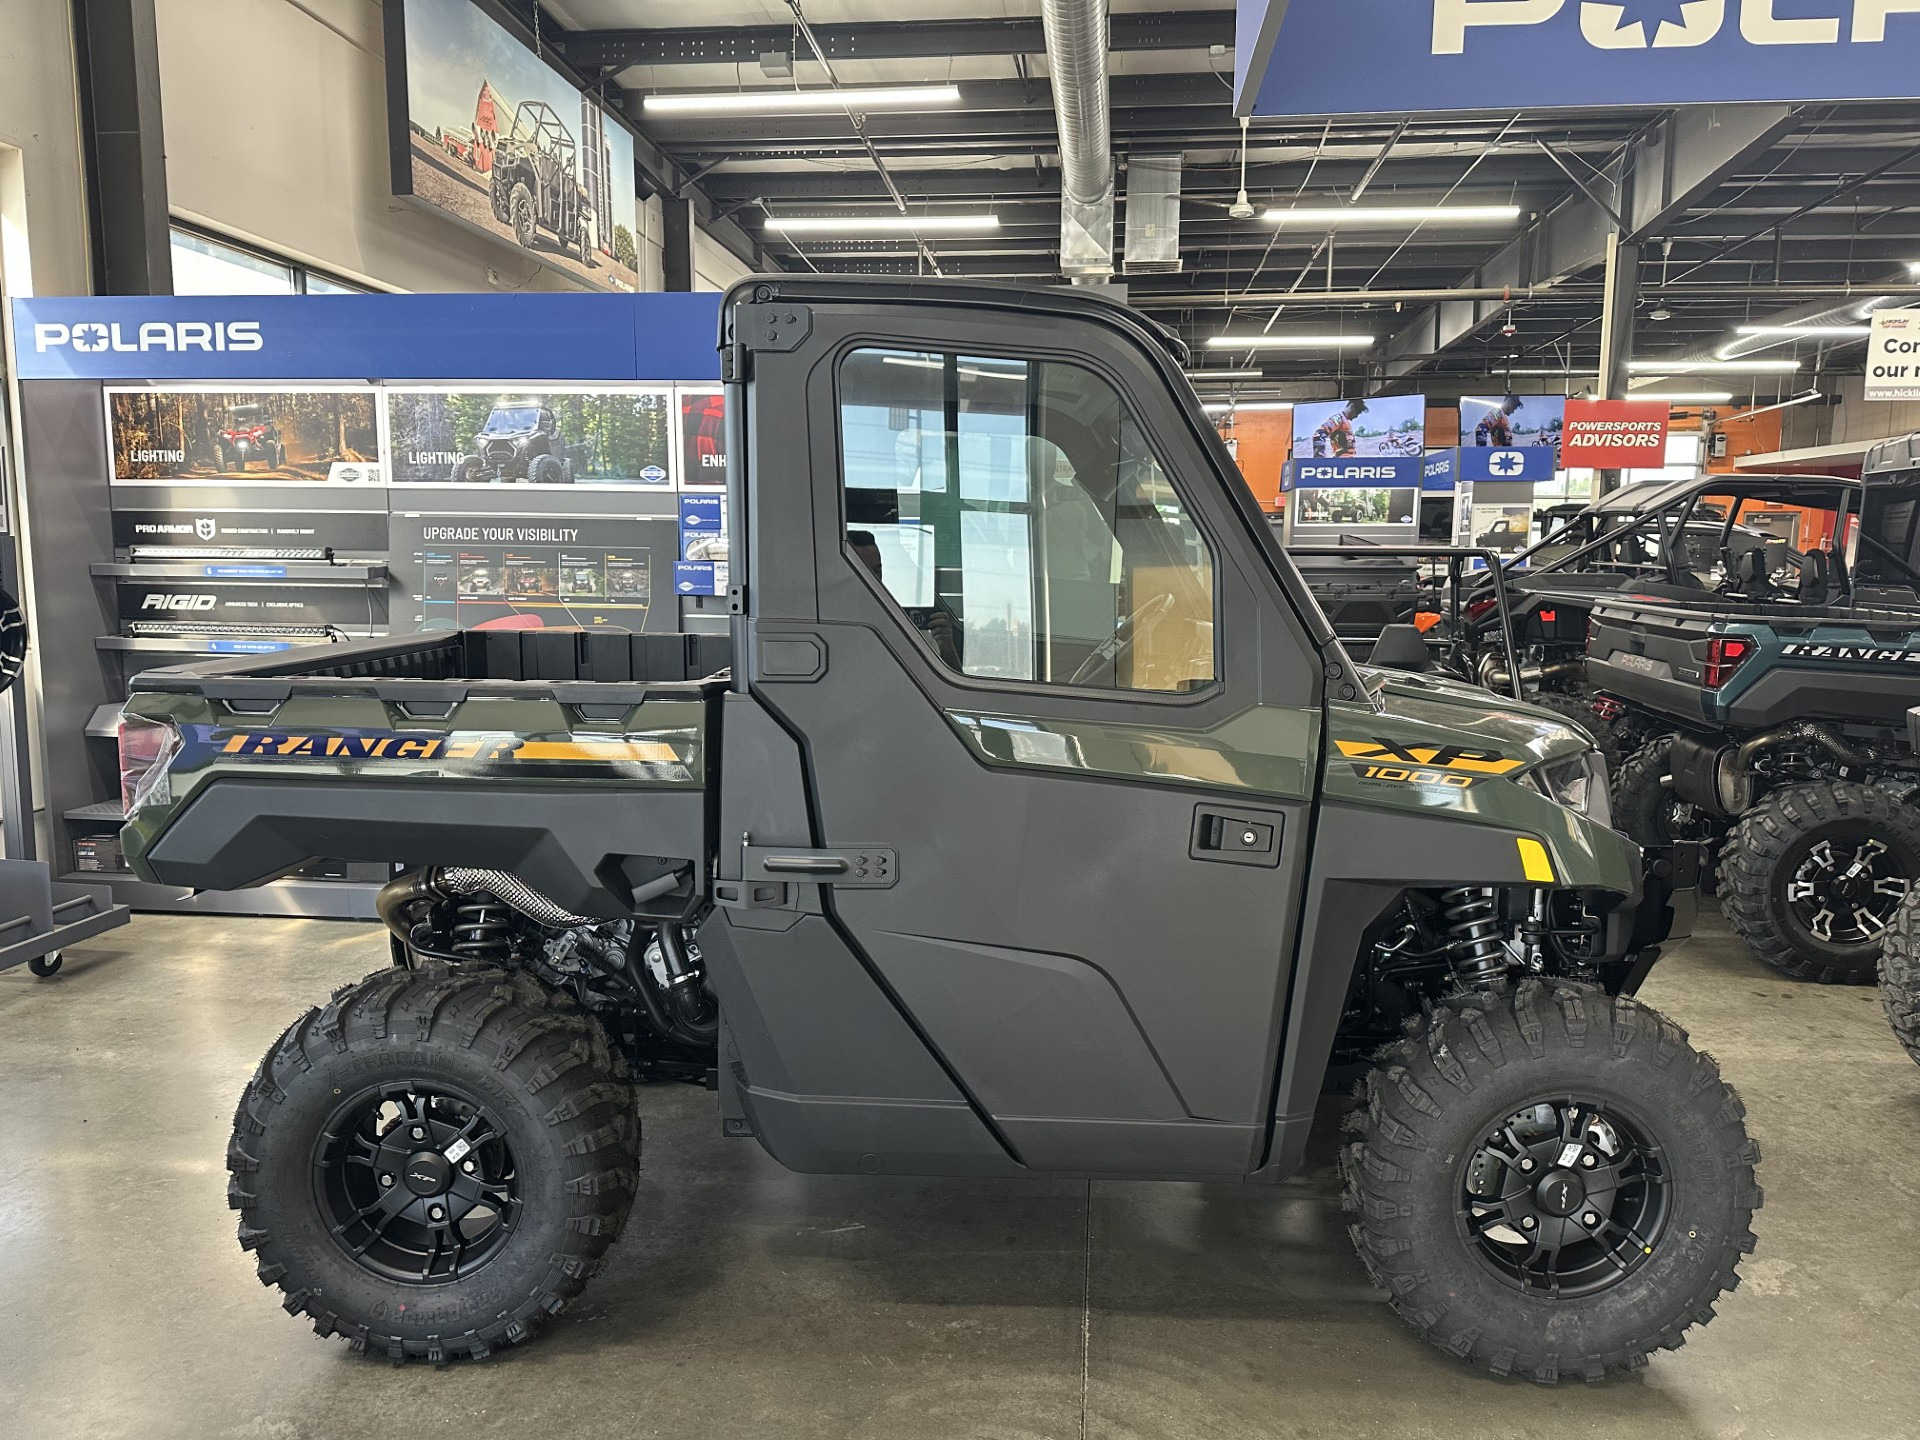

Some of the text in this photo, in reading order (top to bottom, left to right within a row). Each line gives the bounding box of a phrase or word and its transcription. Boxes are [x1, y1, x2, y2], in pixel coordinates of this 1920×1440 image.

[34, 321, 264, 353] POLARIS
[1872, 365, 1909, 378] our
[1568, 421, 1662, 432] POWERSPORTS
[1568, 433, 1661, 448] ADVISORS
[130, 449, 186, 464] LIGHTING
[408, 451, 465, 465] LIGHTING
[1300, 466, 1397, 480] POLARIS
[1423, 459, 1451, 478] POLARIS
[135, 524, 194, 535] PRO ARMOR
[423, 526, 579, 542] UPGRADE YOUR VISIBILITY
[684, 531, 719, 539] POLARIS
[677, 564, 713, 572] POLARIS
[140, 593, 217, 611] RIGID
[1620, 654, 1655, 672] POLARIS
[1350, 736, 1508, 766] XP
[1363, 765, 1474, 789] 1000
